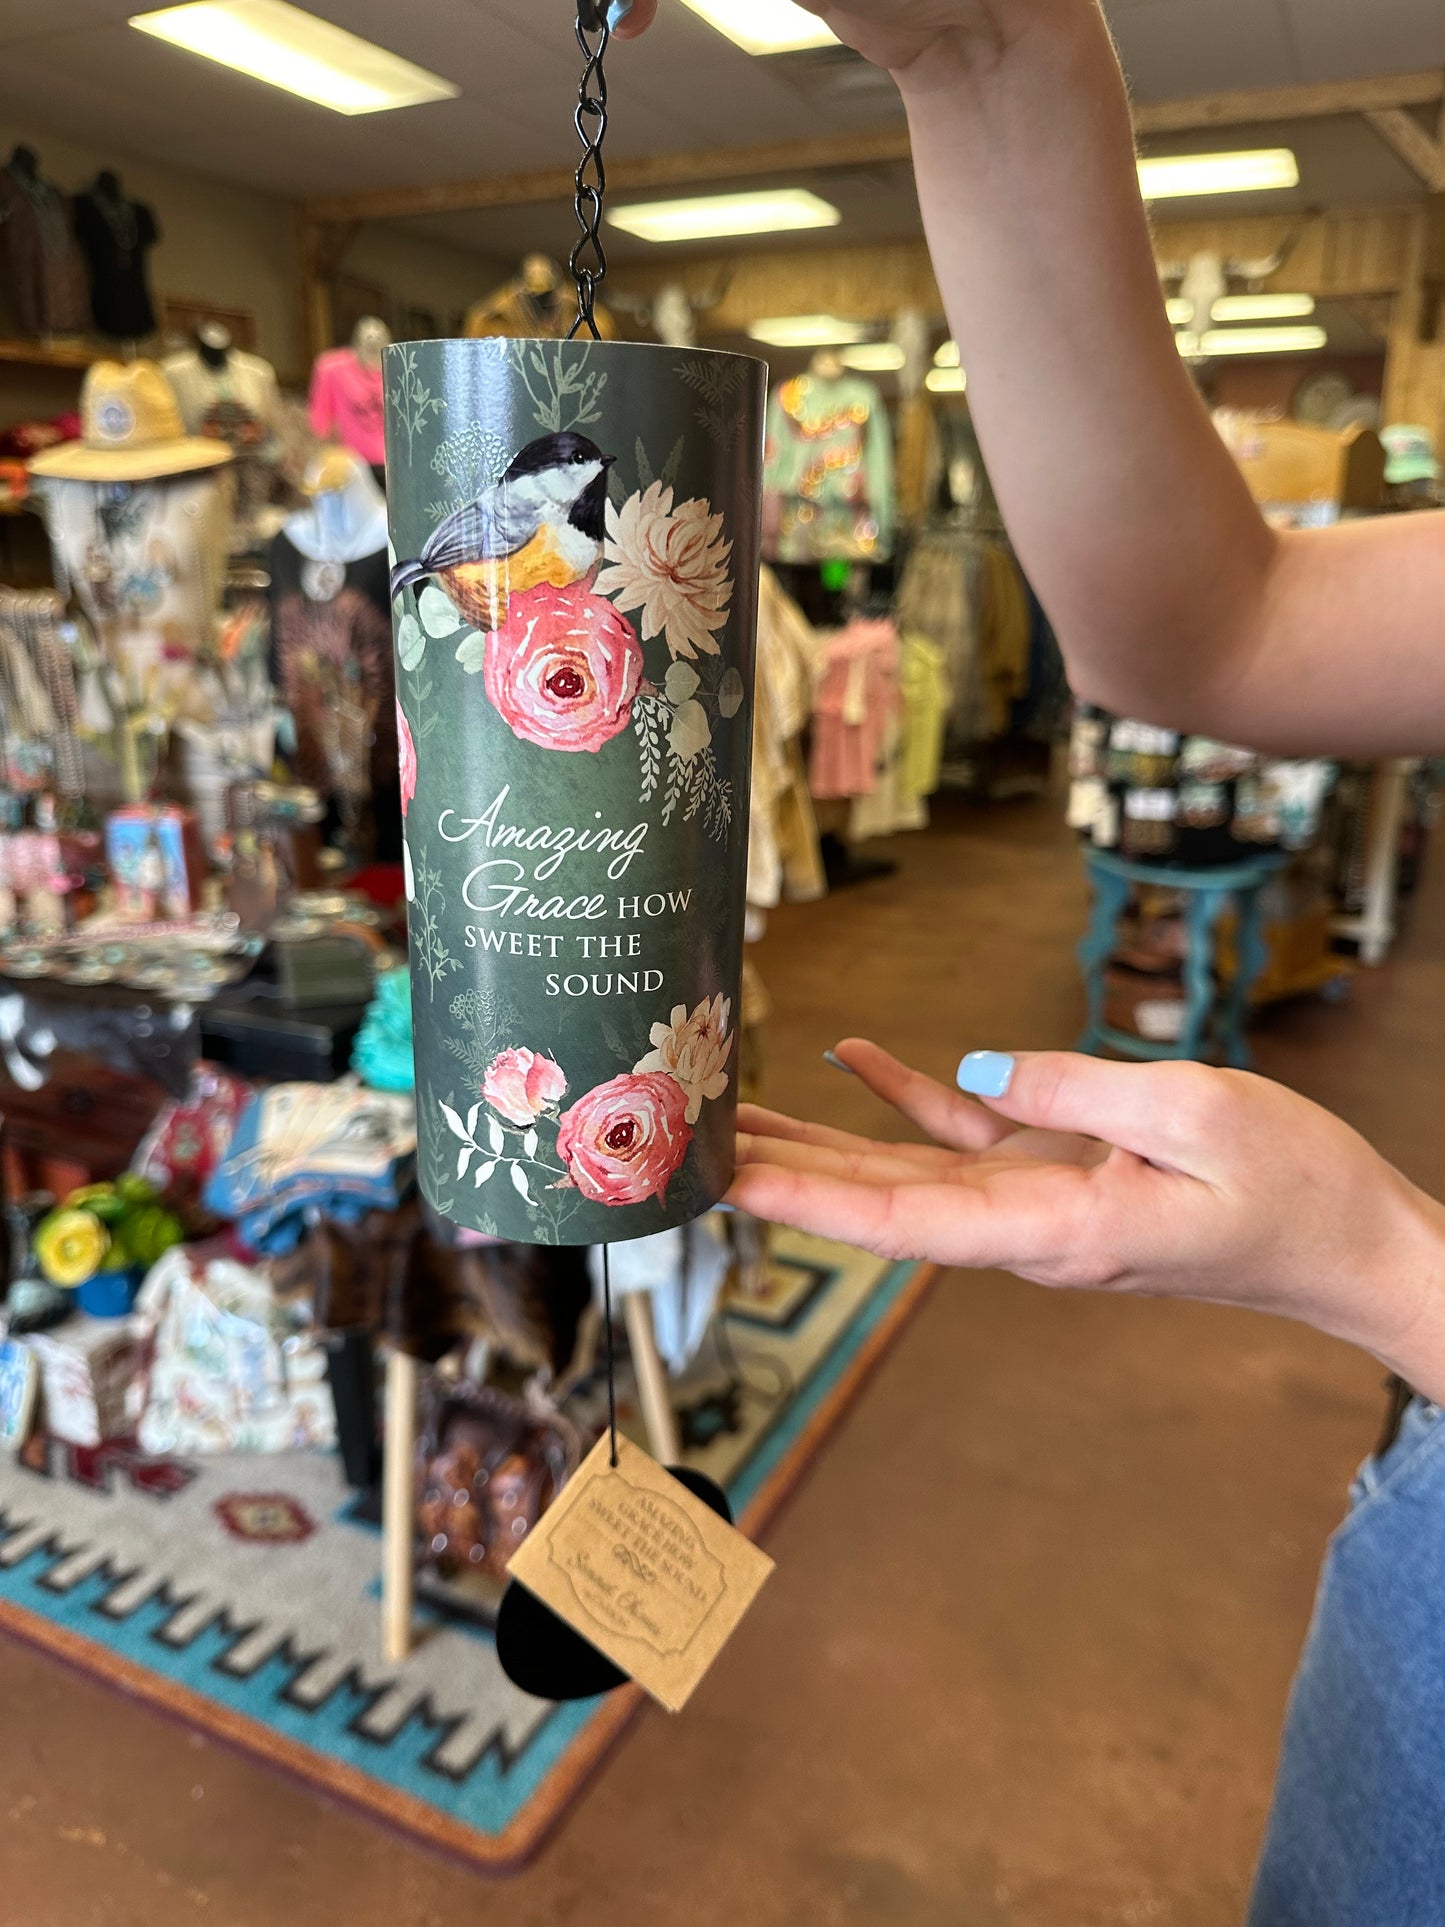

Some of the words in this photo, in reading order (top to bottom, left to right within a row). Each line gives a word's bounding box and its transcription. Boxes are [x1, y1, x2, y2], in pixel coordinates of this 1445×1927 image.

[438, 784, 649, 881] Amazing
[462, 859, 608, 920] Grace
[617, 889, 693, 919] HOW
[464, 925, 564, 957] SWEET
[576, 934, 642, 958] THE
[545, 969, 664, 996] SOUND
